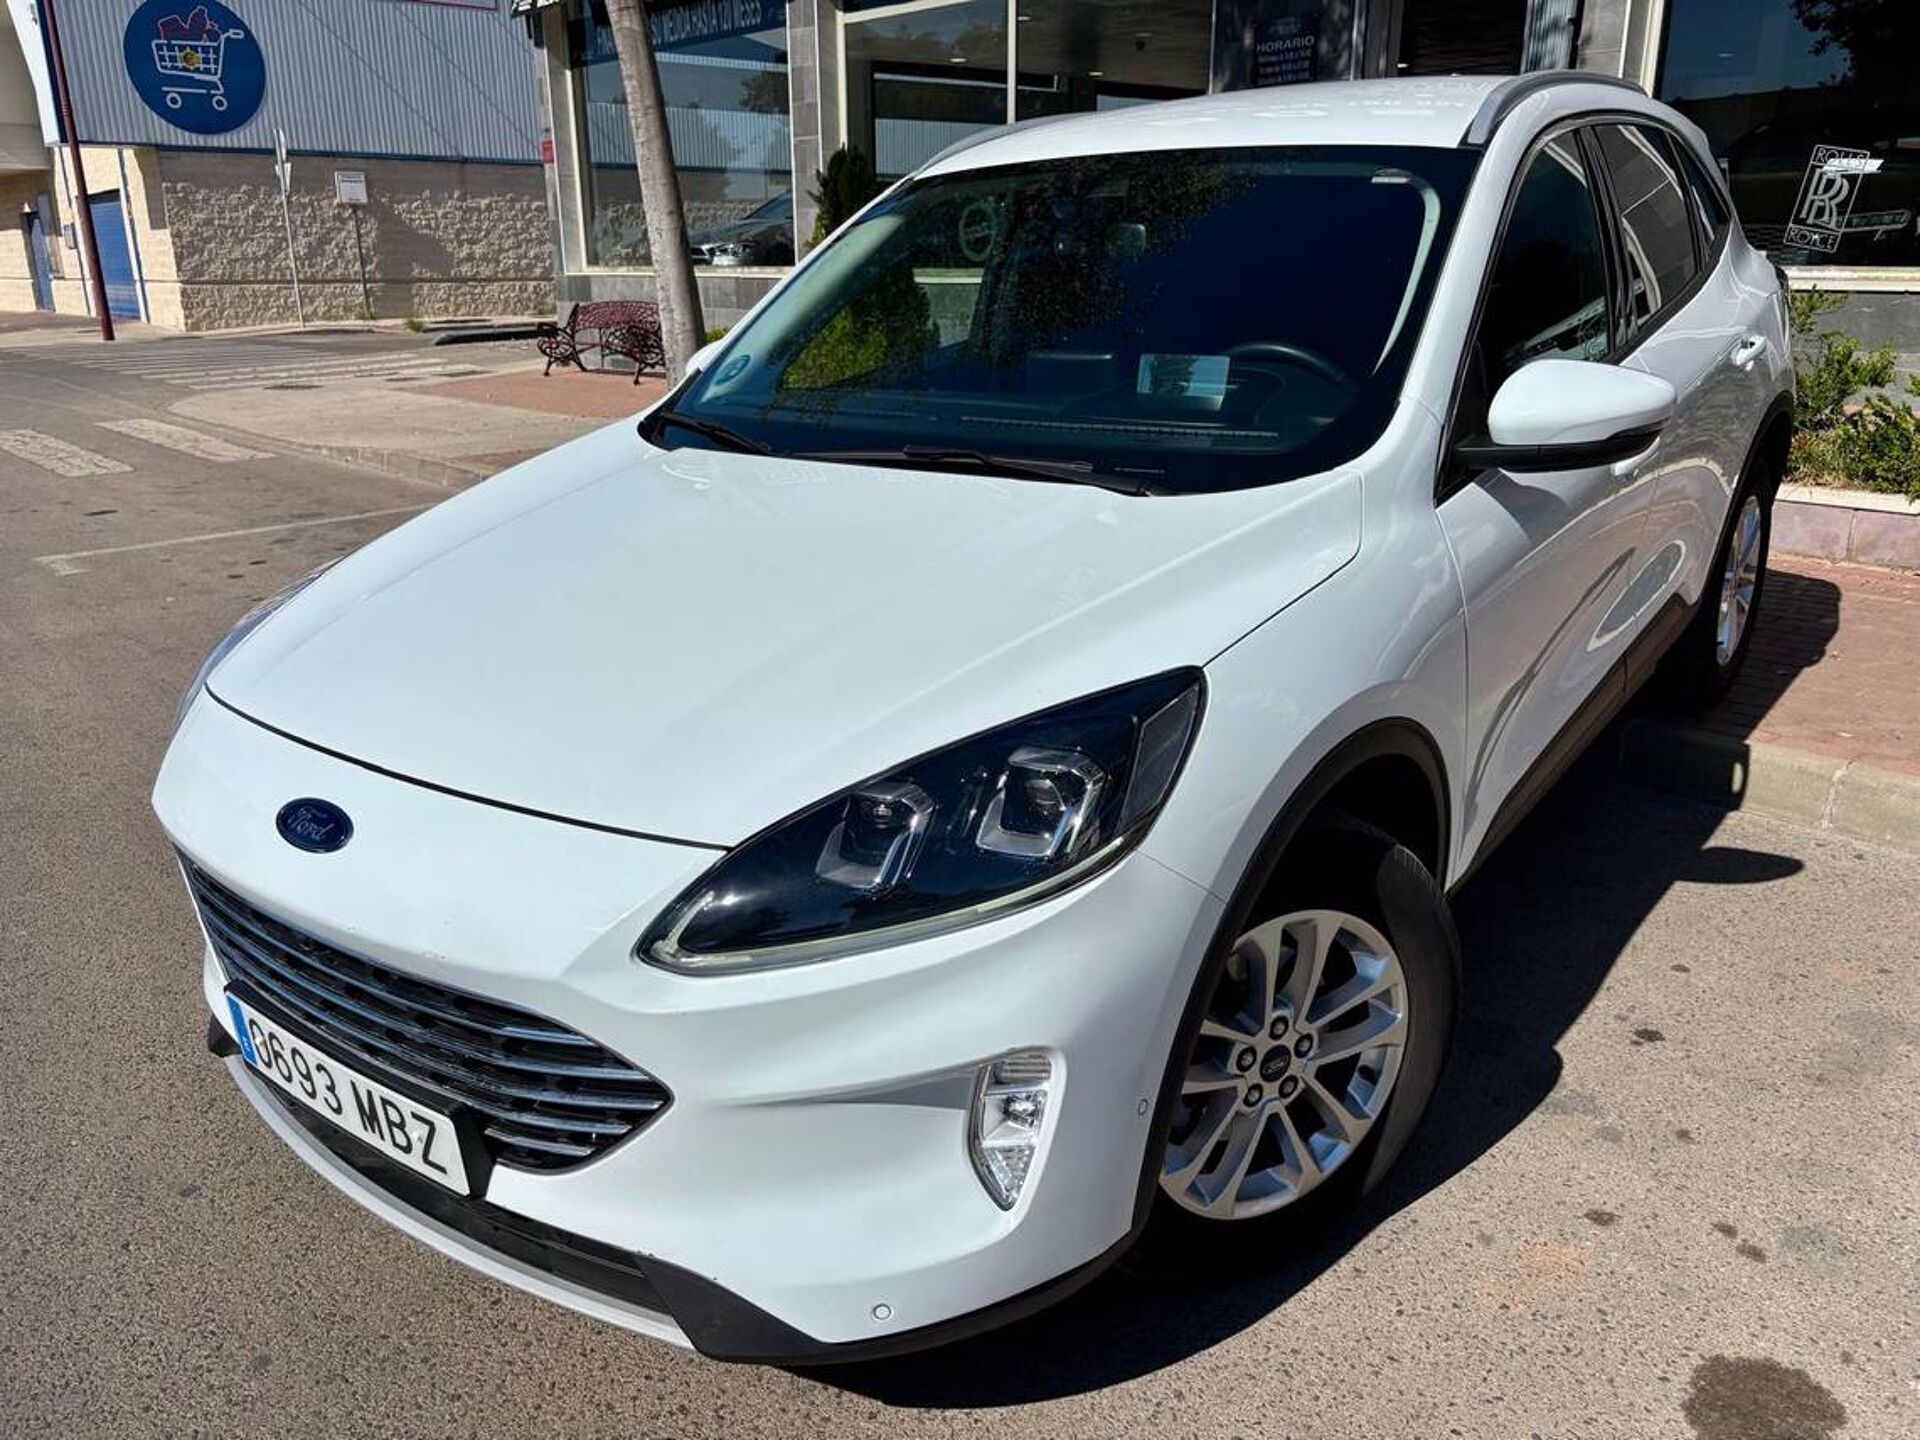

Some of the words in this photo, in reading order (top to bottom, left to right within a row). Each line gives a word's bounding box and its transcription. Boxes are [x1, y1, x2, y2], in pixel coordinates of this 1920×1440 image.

[1255, 35, 1315, 55] HORARIO
[249, 1018, 343, 1116] 0693
[350, 1078, 448, 1175] MBZ
